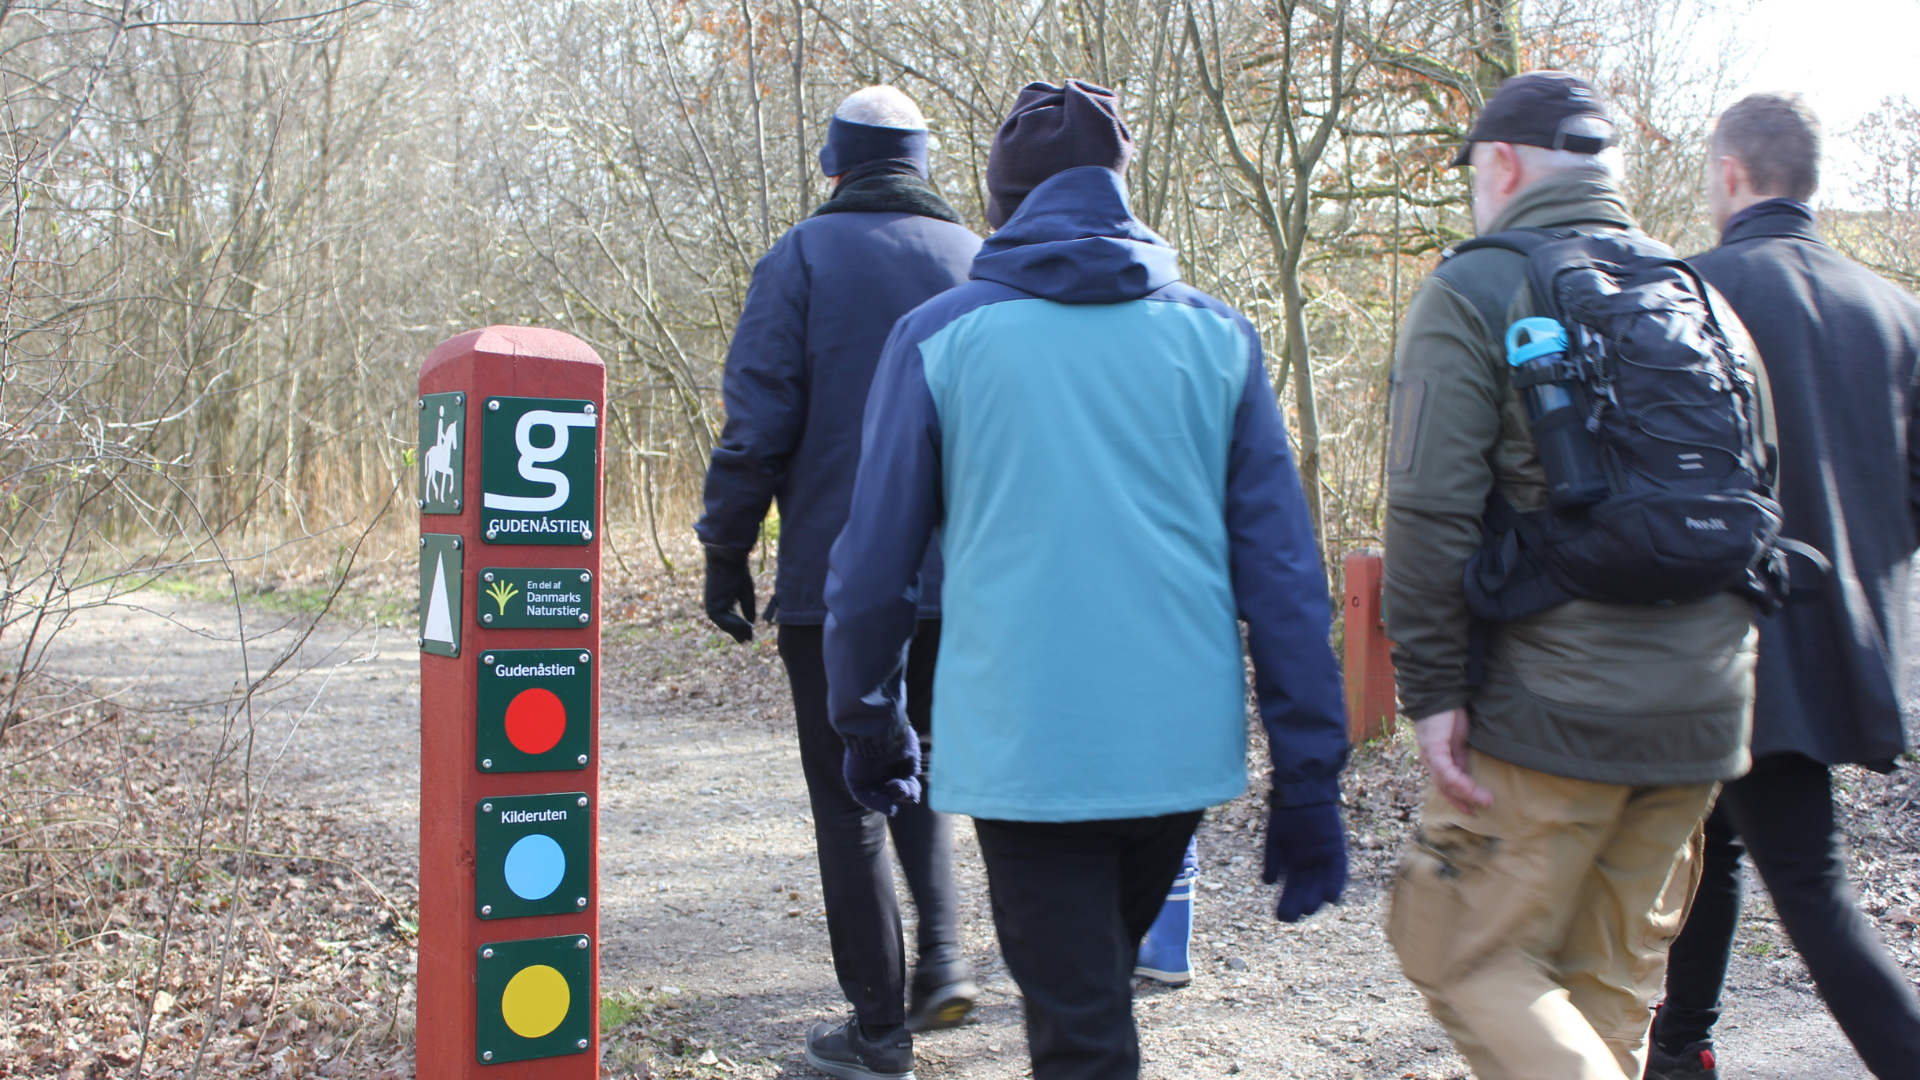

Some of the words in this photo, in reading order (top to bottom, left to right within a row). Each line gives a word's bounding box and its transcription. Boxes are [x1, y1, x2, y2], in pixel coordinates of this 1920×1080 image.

[489, 516, 590, 533] GUDENÅSTIEN
[527, 581, 538, 589] En
[539, 581, 552, 589] del
[553, 581, 562, 589] af
[527, 592, 581, 602] Danmarks
[526, 605, 581, 616] Naturstier
[495, 663, 575, 677] Gudenåstien
[501, 809, 567, 824] Kilderuten
